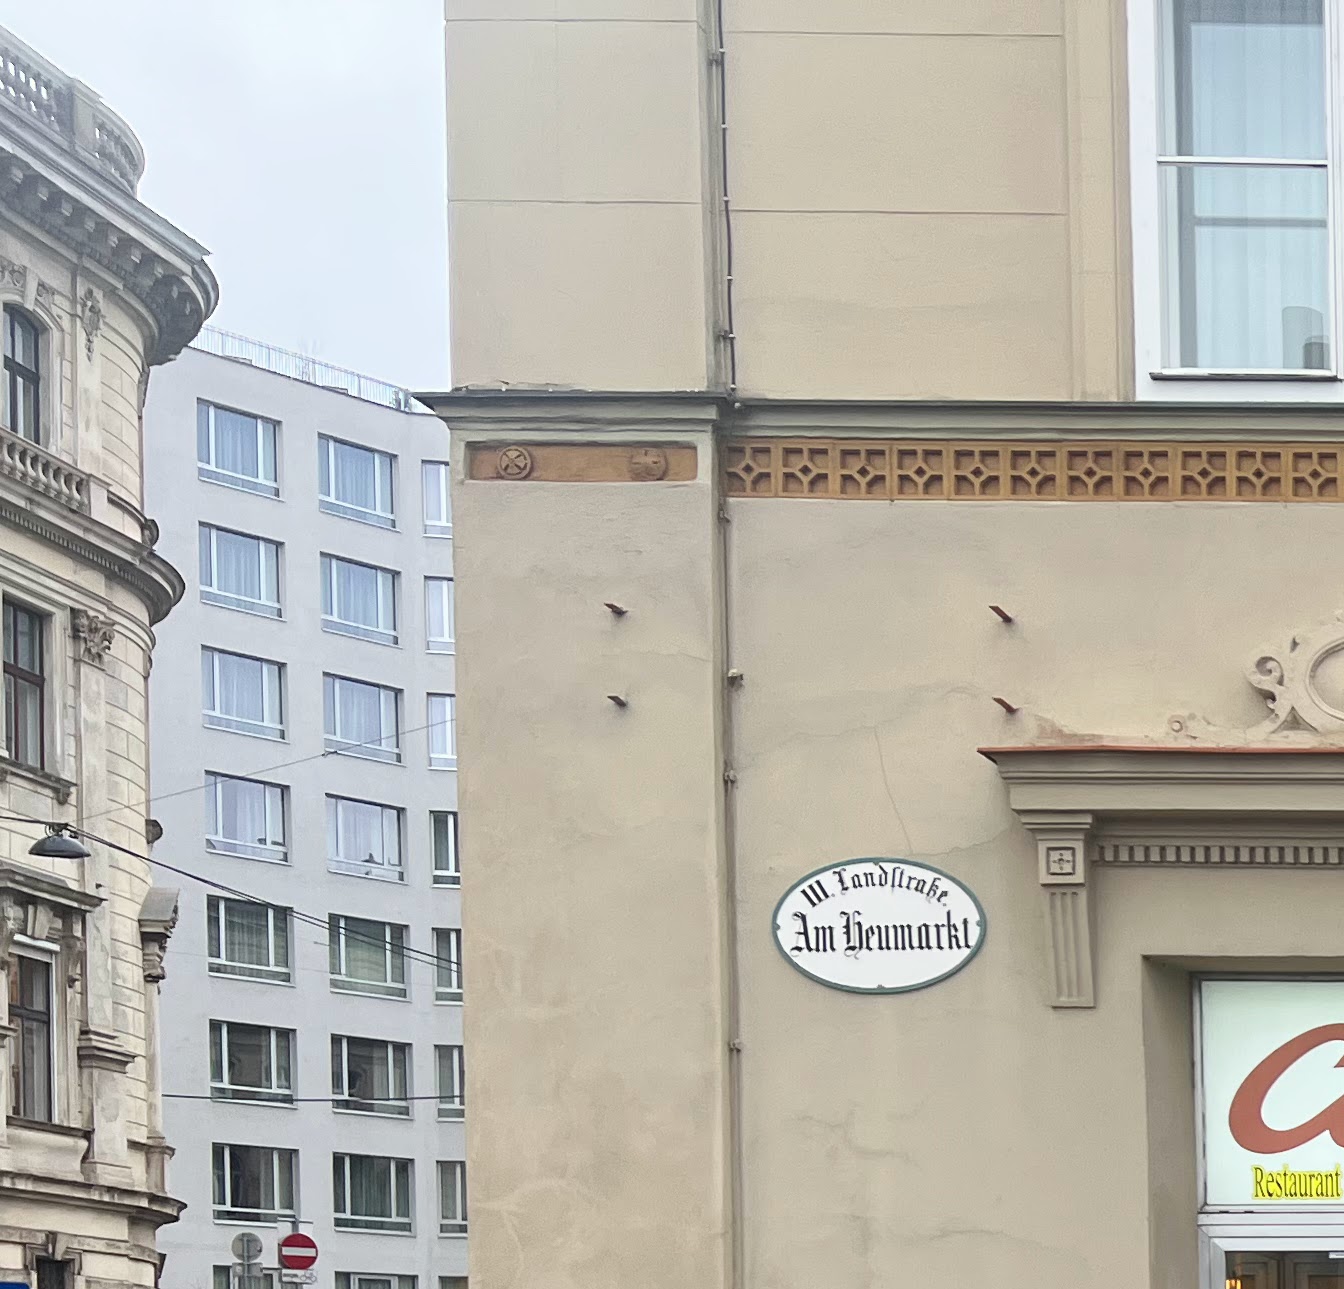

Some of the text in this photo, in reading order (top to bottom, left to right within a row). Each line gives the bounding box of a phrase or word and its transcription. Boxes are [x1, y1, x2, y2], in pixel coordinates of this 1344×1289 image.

[790, 909, 973, 960] Am Heumarkt
[1253, 1164, 1342, 1198] Restaurant
